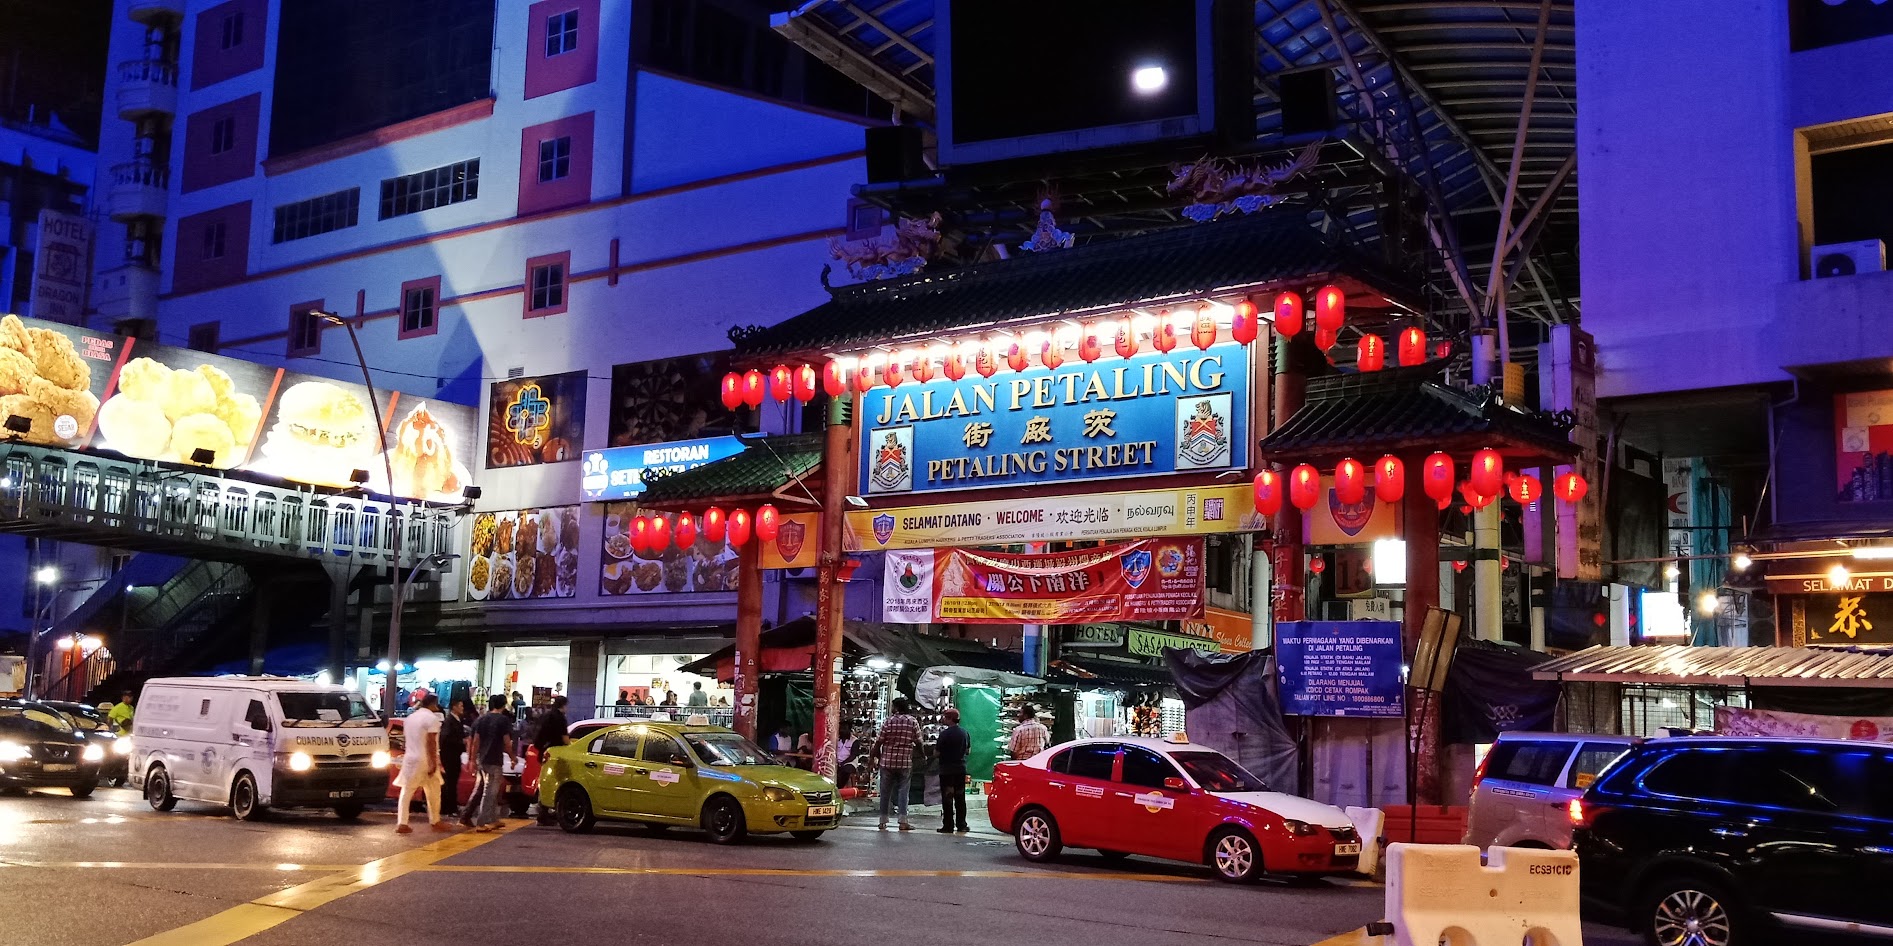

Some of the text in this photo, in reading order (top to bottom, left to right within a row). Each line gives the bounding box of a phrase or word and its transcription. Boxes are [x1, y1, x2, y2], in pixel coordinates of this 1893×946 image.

[44, 217, 87, 242] HOTEL
[38, 285, 79, 304] DRAGON
[49, 302, 66, 316] INN
[876, 354, 1225, 424] JALAN PETALING
[643, 445, 709, 465] RESTORAN
[927, 440, 1157, 482] PETALING STREET
[902, 509, 1044, 531] SELAMAT DATANG WELCOME
[1055, 507, 1109, 525] 欢迎光临
[296, 735, 382, 746] GUARDIAN SECURITY
